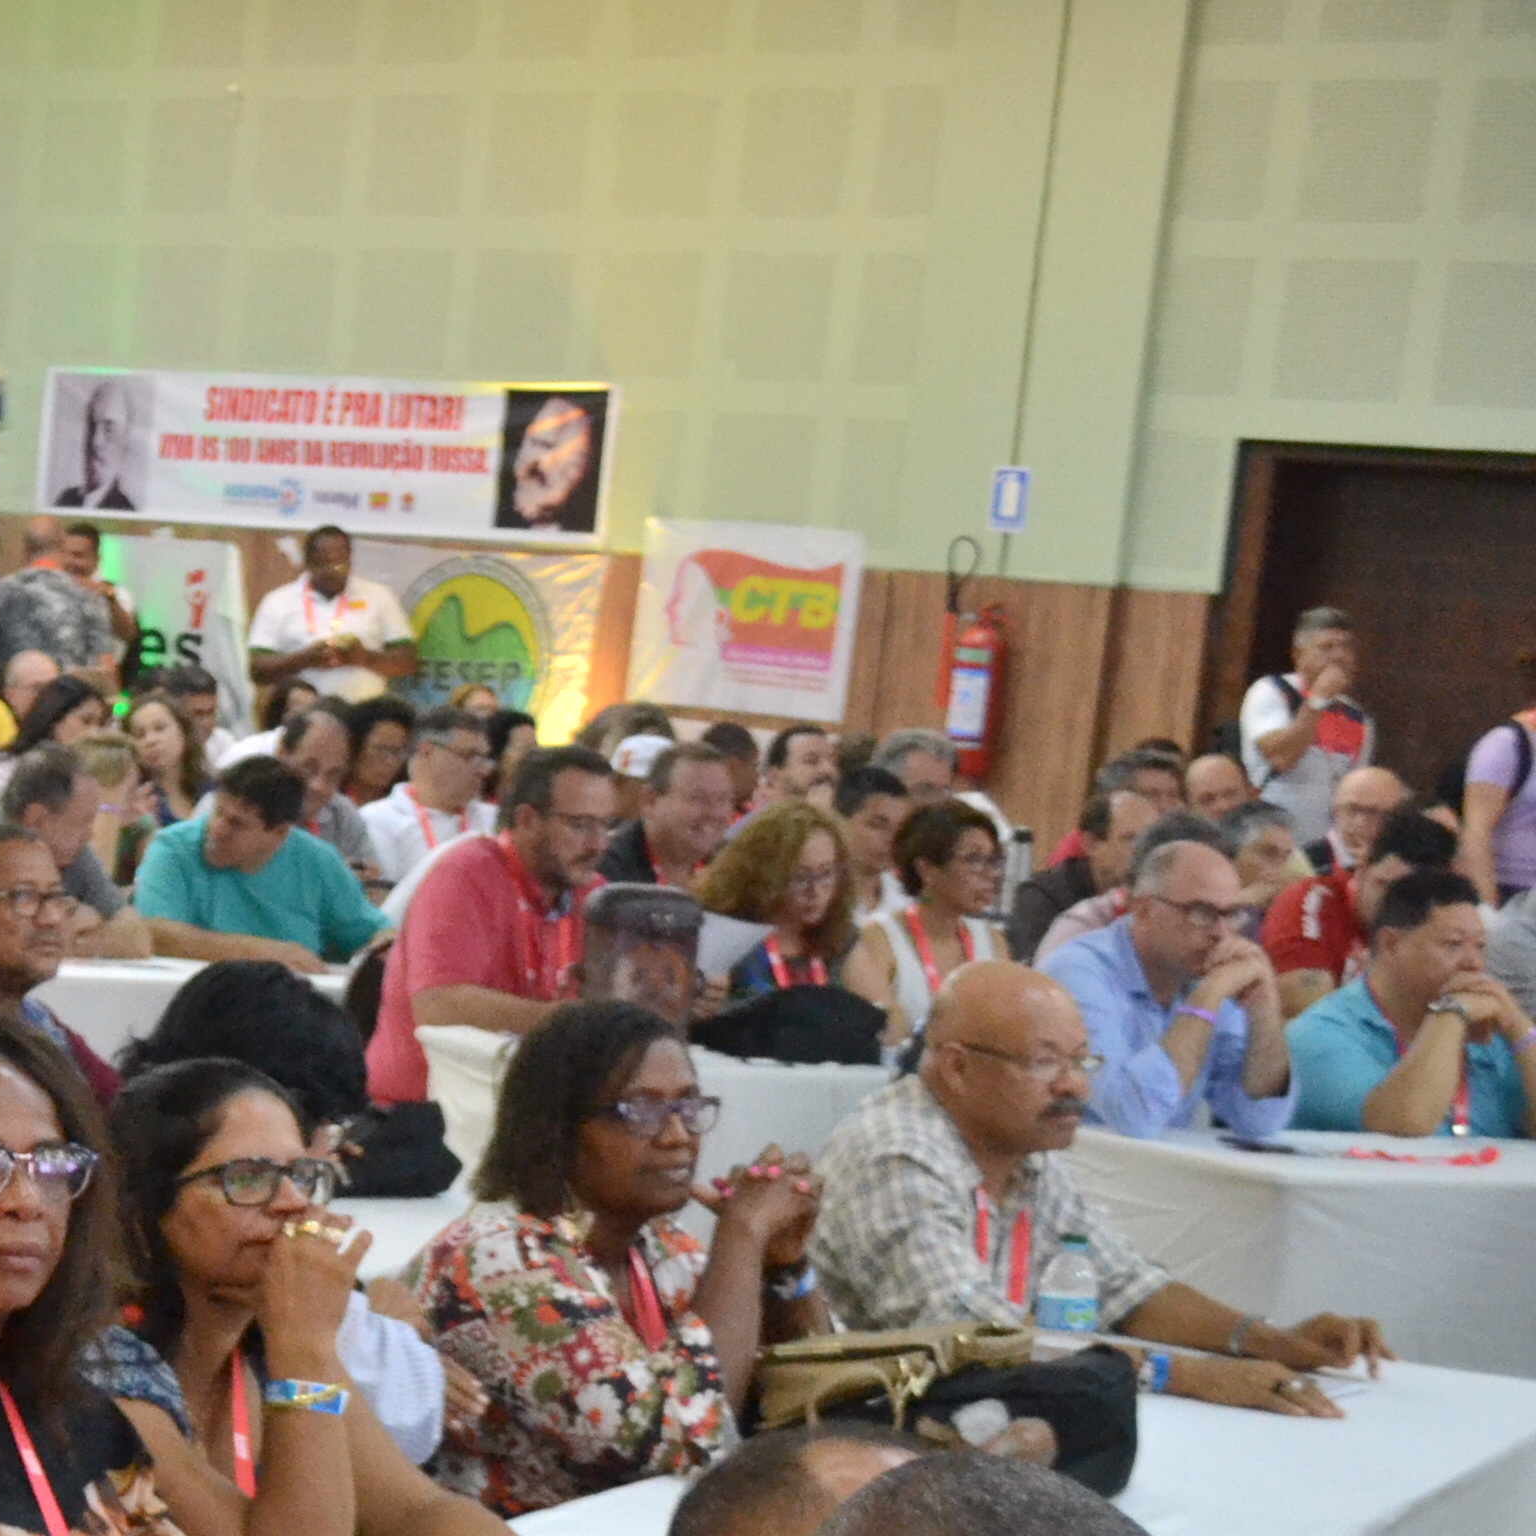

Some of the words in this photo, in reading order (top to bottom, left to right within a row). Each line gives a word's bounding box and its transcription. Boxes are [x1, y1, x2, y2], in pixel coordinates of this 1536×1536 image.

[204, 386, 318, 425] SINDICATO
[338, 391, 381, 428] PRA
[159, 433, 194, 460] VIVA
[200, 435, 219, 461] OS
[257, 438, 298, 466] ANOS
[304, 440, 324, 467] DA
[330, 439, 425, 475] REVOLUÇÃO
[730, 575, 840, 629] CTB
